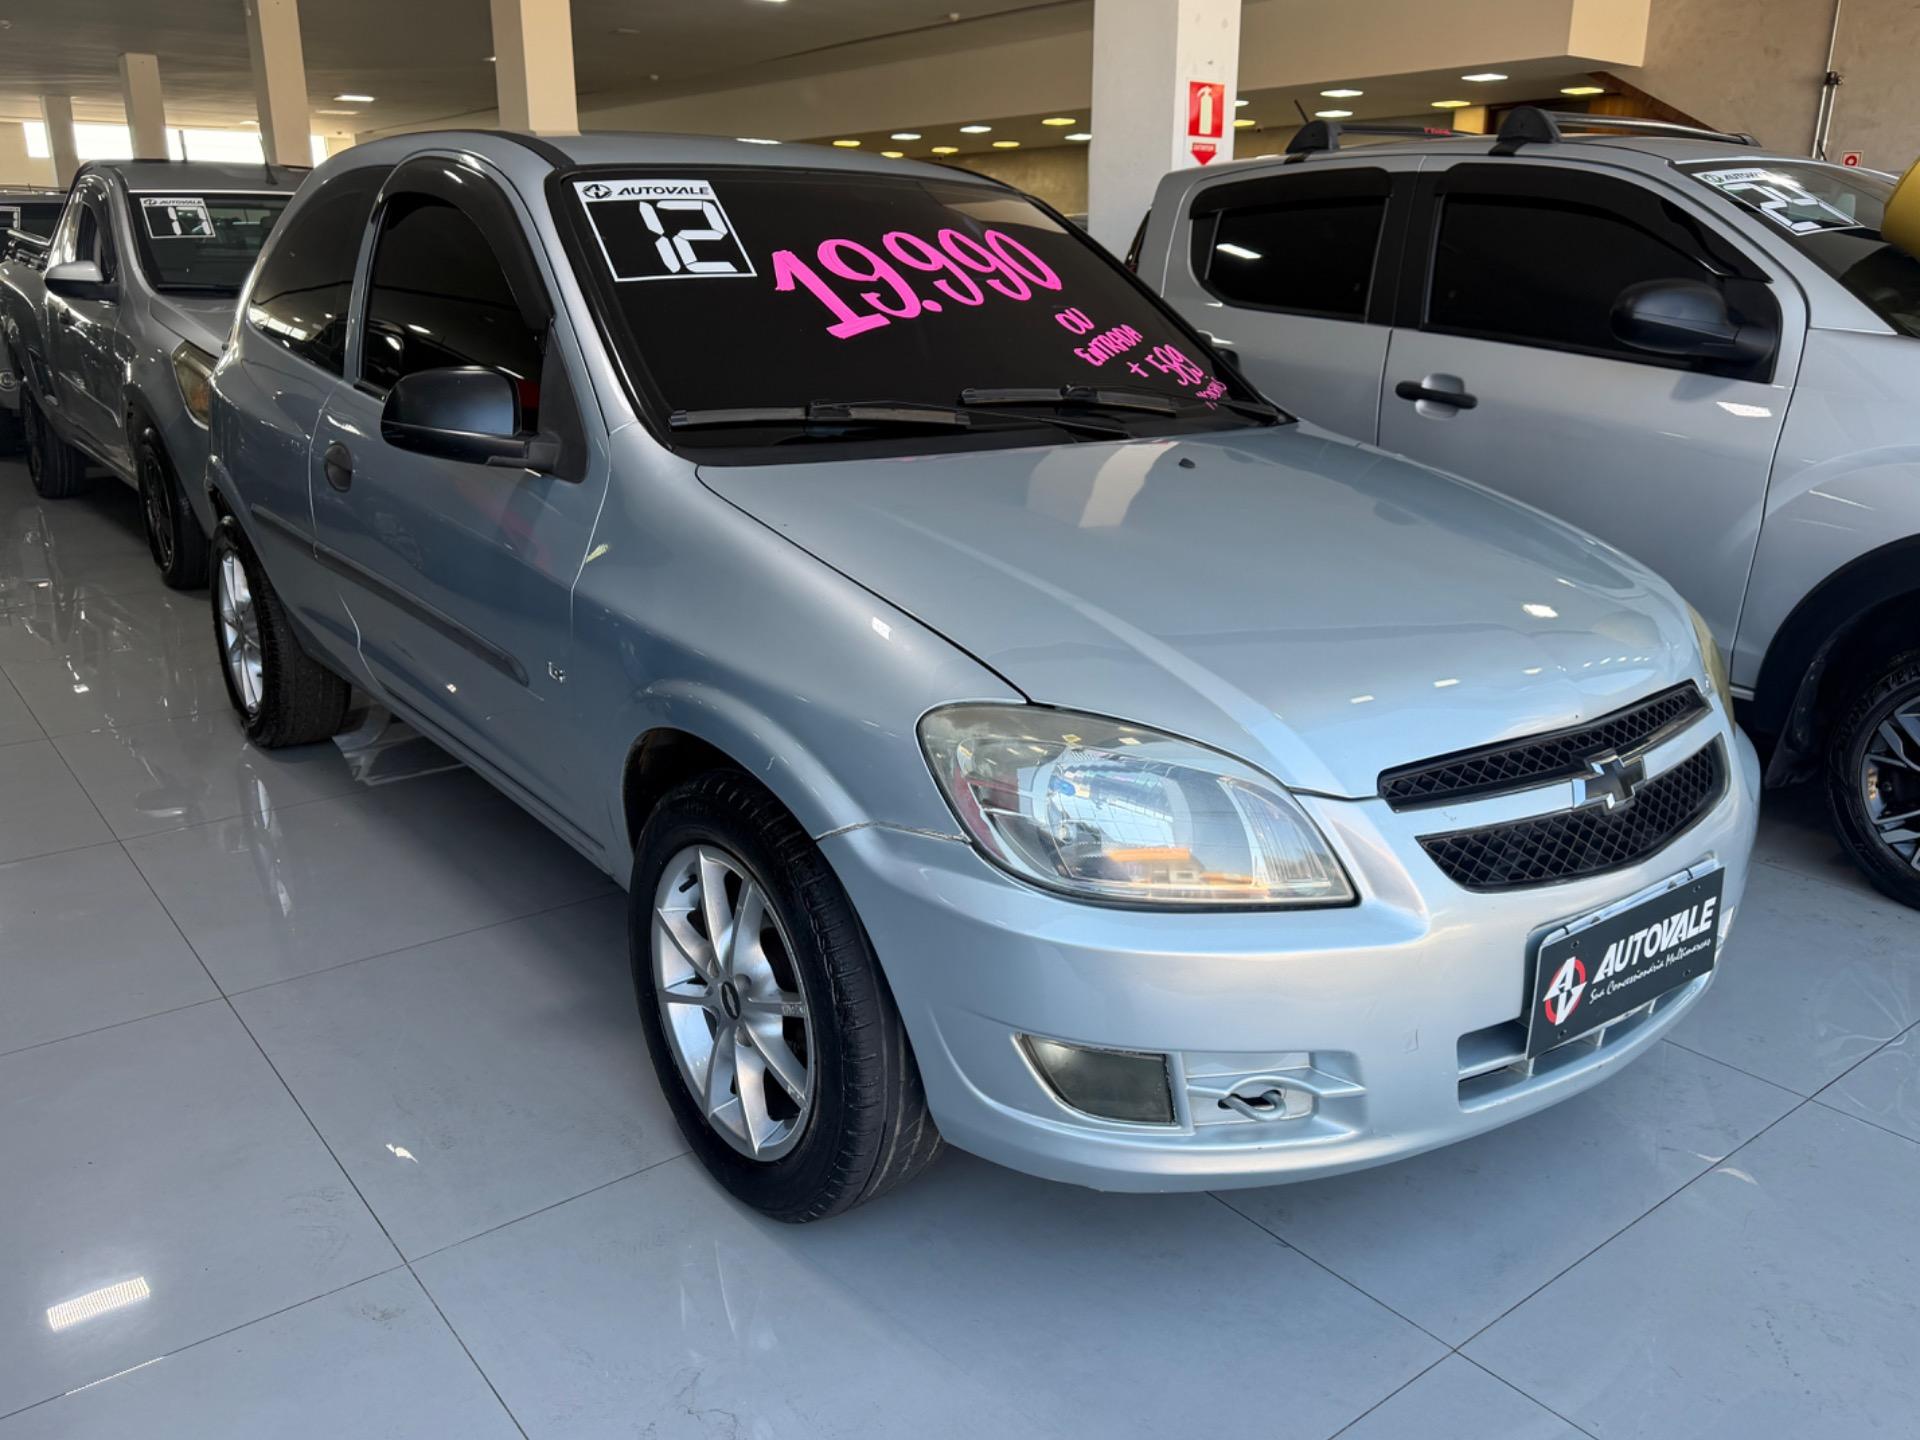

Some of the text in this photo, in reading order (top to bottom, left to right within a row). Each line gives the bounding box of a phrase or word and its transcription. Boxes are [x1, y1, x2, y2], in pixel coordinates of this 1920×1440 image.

[617, 185, 709, 197] AUTOVALE
[168, 206, 212, 236] 17
[638, 200, 738, 274] 12
[771, 228, 1063, 340] 19.990
[1054, 307, 1095, 335] OU
[1073, 323, 1144, 367] ENTRADA
[1144, 343, 1204, 387] 589
[1592, 896, 1717, 985] AUTOVALE
